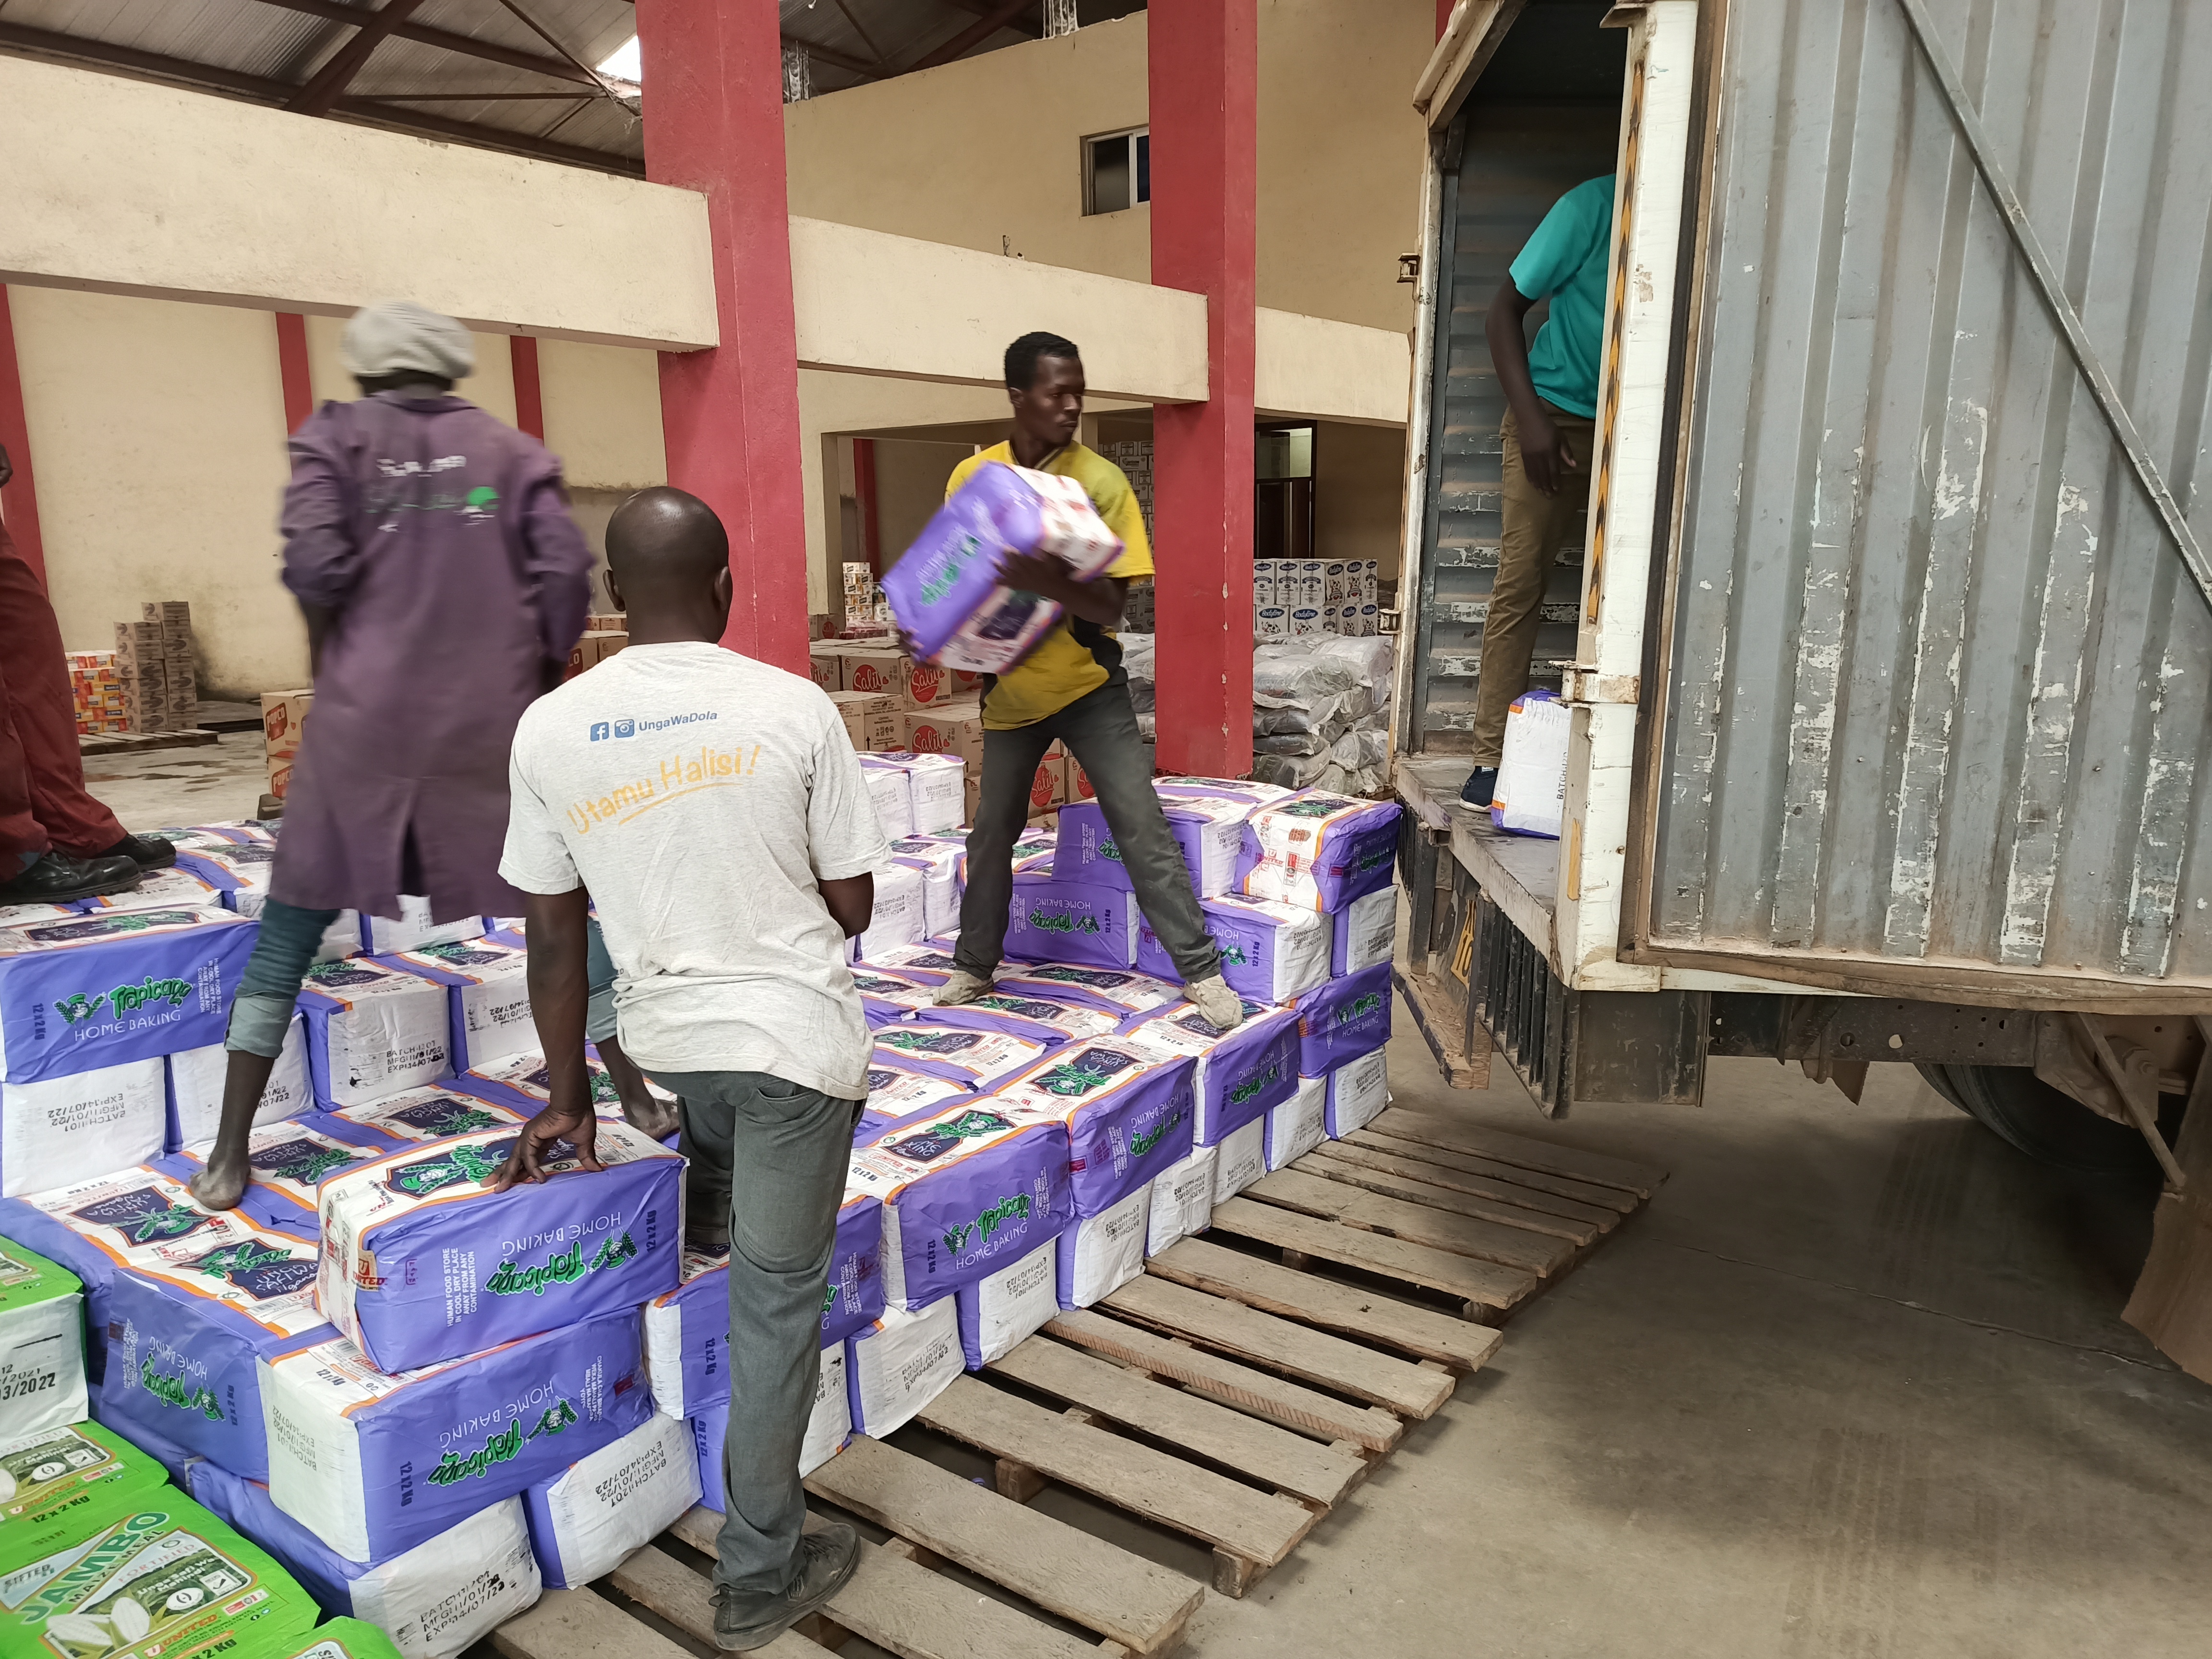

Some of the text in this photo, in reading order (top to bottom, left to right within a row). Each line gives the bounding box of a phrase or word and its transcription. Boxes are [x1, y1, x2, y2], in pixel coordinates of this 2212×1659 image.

[1262, 610, 1282, 618] Bodyline
[1295, 611, 1316, 620] Bodyline
[854, 668, 882, 692] Salit
[912, 669, 939, 693] Salit
[638, 711, 718, 731] UngaWaDola
[913, 729, 943, 753] Salit
[566, 745, 760, 835] Utamu Halisi!
[1035, 897, 1091, 910] HOME BAKING
[1029, 906, 1074, 934] Tropicana
[1210, 926, 1239, 940] HOME
[109, 976, 193, 1019] Tropicana
[74, 1010, 180, 1041] HOME BAKING
[1342, 1015, 1379, 1038] HOME BAKING
[1159, 1094, 1179, 1112] HOME
[1131, 1107, 1159, 1128] BAKING
[502, 1211, 621, 1256] HOME BAKING
[956, 1222, 1028, 1270] HOME BAKING
[443, 1248, 451, 1274] STORE
[459, 1253, 468, 1268] ANY
[484, 1240, 586, 1296] Tropicana
[451, 1248, 462, 1323] IN COOL DRY PLACE
[461, 1270, 469, 1290] FROM
[840, 1266, 849, 1315] CONTAMINATION
[177, 1354, 208, 1381] HOME
[506, 1381, 554, 1419] HOME
[439, 1408, 501, 1448] BAKING
[427, 1418, 524, 1487] Tropicana
[22, 1512, 168, 1623] JAMBO
[69, 1563, 118, 1603] MAIZE
[122, 1529, 164, 1559] MEAL
[118, 1544, 195, 1583] FORTIFIED
[163, 1614, 217, 1646] UNITED
